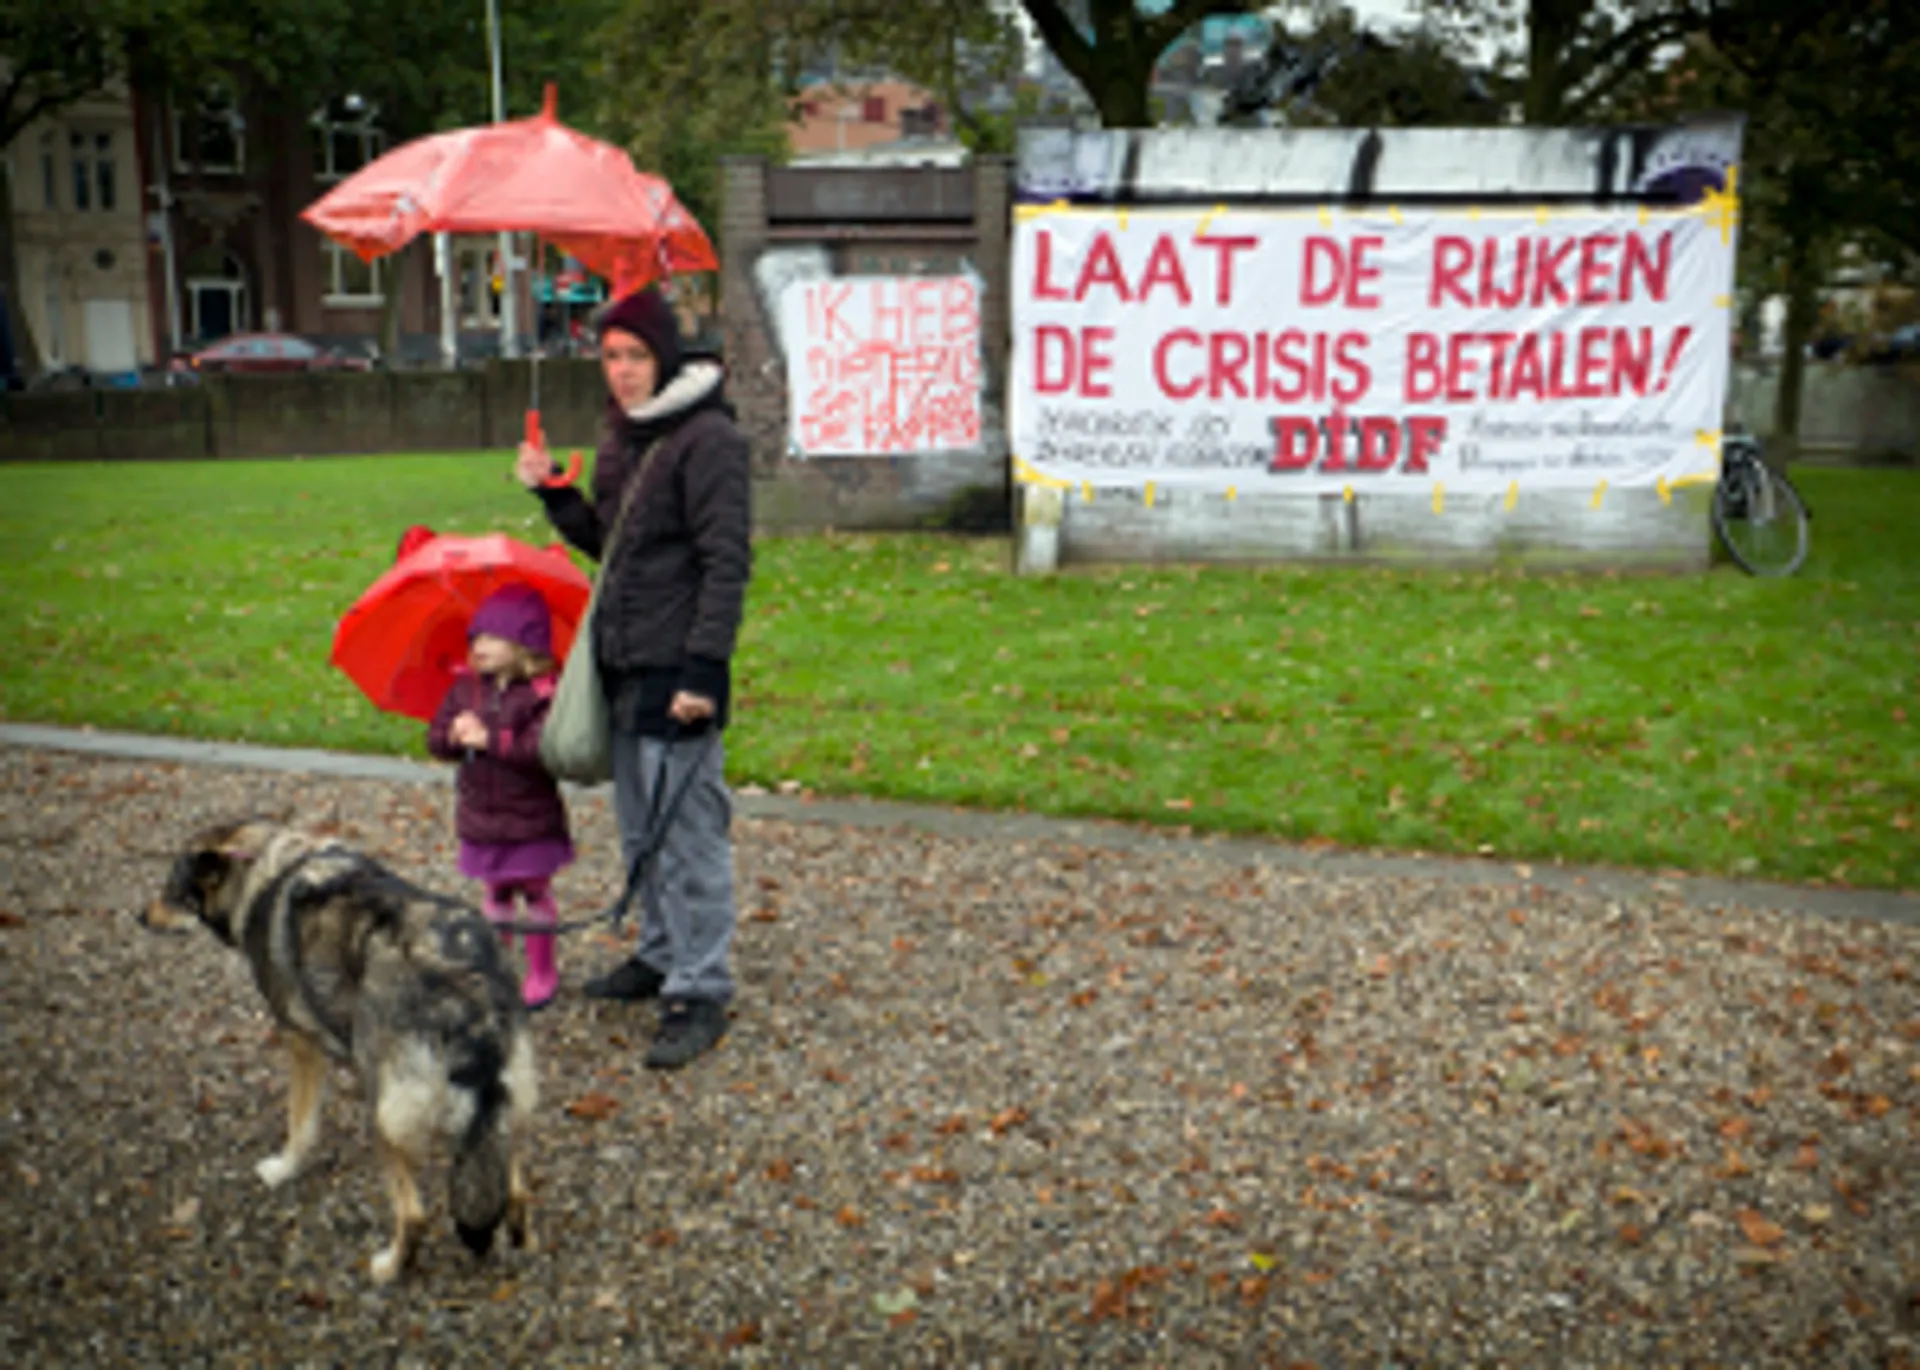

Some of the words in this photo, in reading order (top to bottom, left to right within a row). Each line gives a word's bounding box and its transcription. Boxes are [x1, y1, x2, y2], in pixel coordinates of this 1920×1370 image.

[1030, 230, 1261, 306] LAAT
[1298, 234, 1386, 310] DE
[804, 282, 856, 342] IK
[869, 277, 980, 343] HEB
[1032, 324, 1116, 398] DE
[1152, 327, 1372, 403] CRISIS
[1402, 324, 1694, 403] BETALEN!
